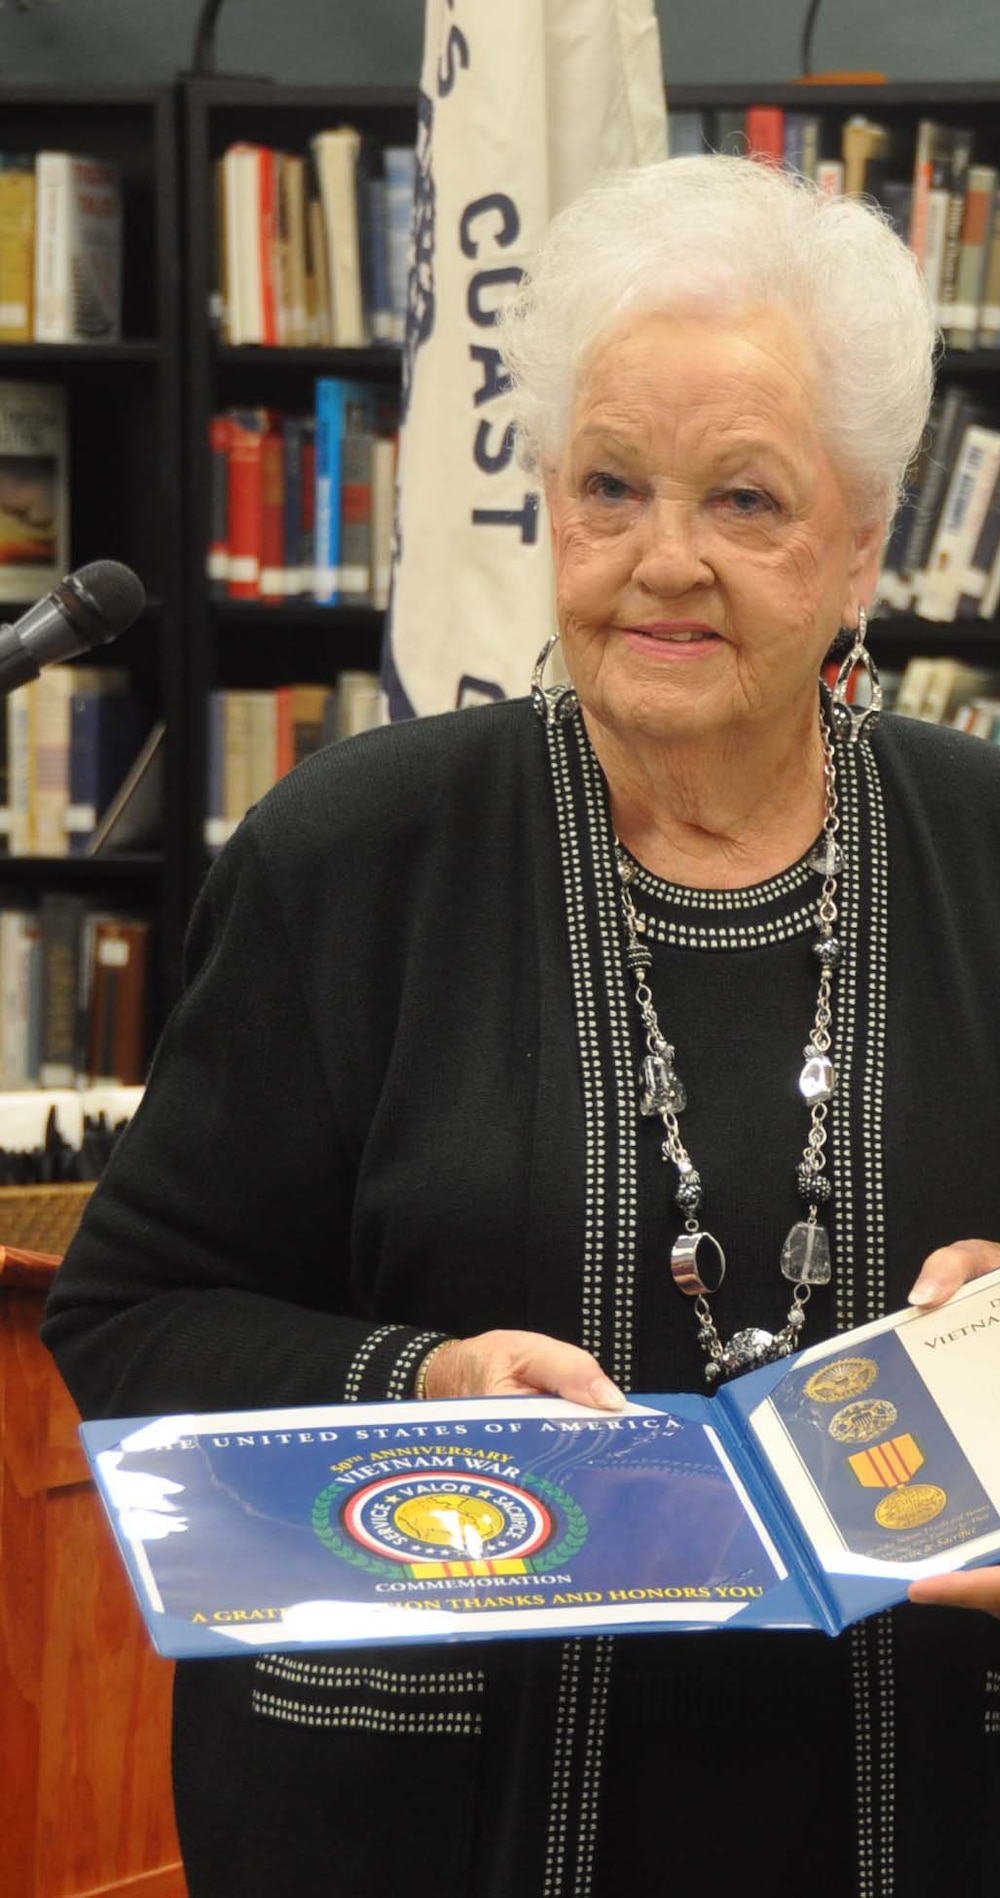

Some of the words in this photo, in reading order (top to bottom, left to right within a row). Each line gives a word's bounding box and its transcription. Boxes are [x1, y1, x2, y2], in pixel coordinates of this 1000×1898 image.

[213, 1431, 339, 1448] UNITED
[356, 1424, 468, 1440] STATES
[485, 1422, 522, 1434] OF
[540, 1417, 683, 1433] AMERICA
[370, 1445, 515, 1463] ANNIVERSARY
[335, 1456, 455, 1485] VIETNAM
[465, 1456, 520, 1479] WAR
[399, 1482, 471, 1497] VALOR
[370, 1502, 408, 1546] SERVICE
[493, 1495, 528, 1540] SACRIFICE
[375, 1574, 572, 1593] COMMEMORATION
[192, 1612, 208, 1624] A
[452, 1594, 546, 1611] THANKS
[552, 1590, 602, 1604] AND
[608, 1586, 711, 1601] HONORS
[715, 1585, 765, 1599] YOU
